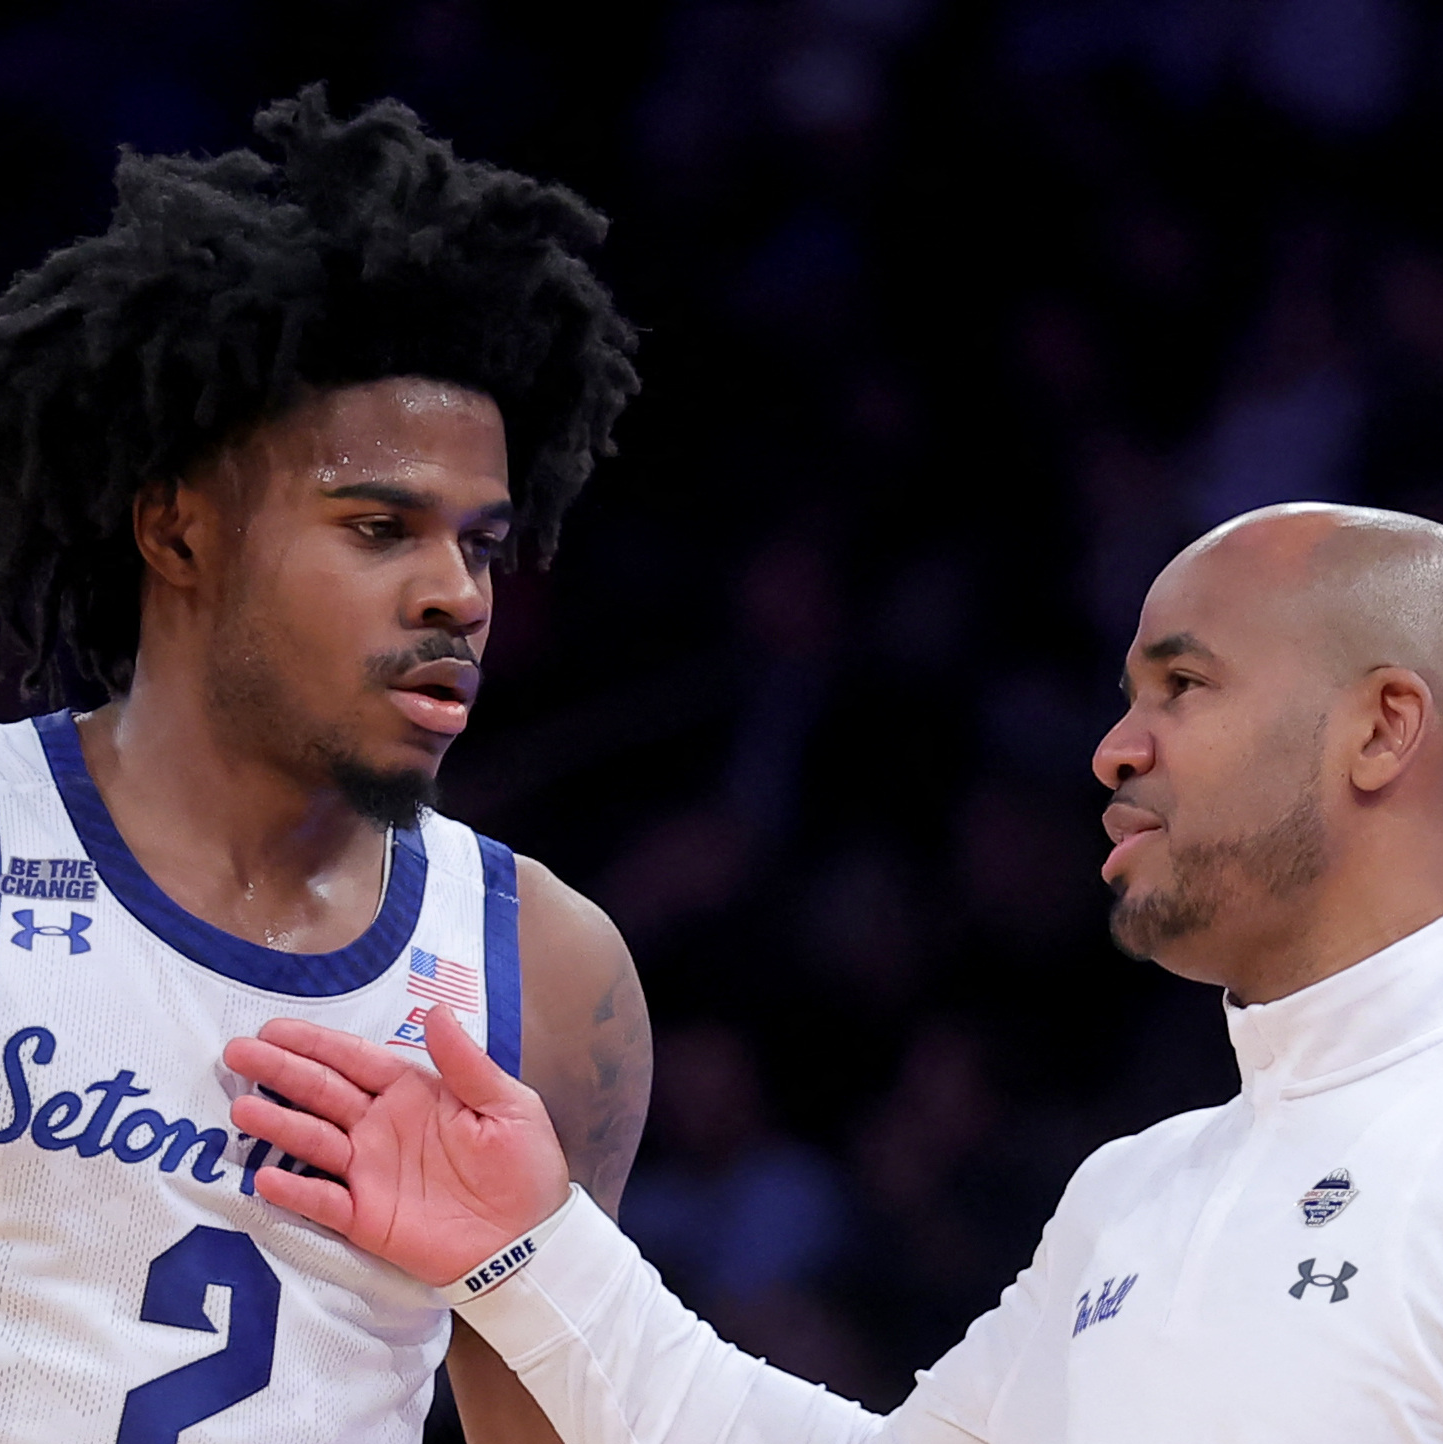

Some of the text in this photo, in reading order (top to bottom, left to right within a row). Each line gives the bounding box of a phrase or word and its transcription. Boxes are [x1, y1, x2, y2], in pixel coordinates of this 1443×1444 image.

[9, 857, 93, 879] BE THE
[1, 875, 98, 899] CHANGE
[464, 1237, 537, 1293] DESIRE
